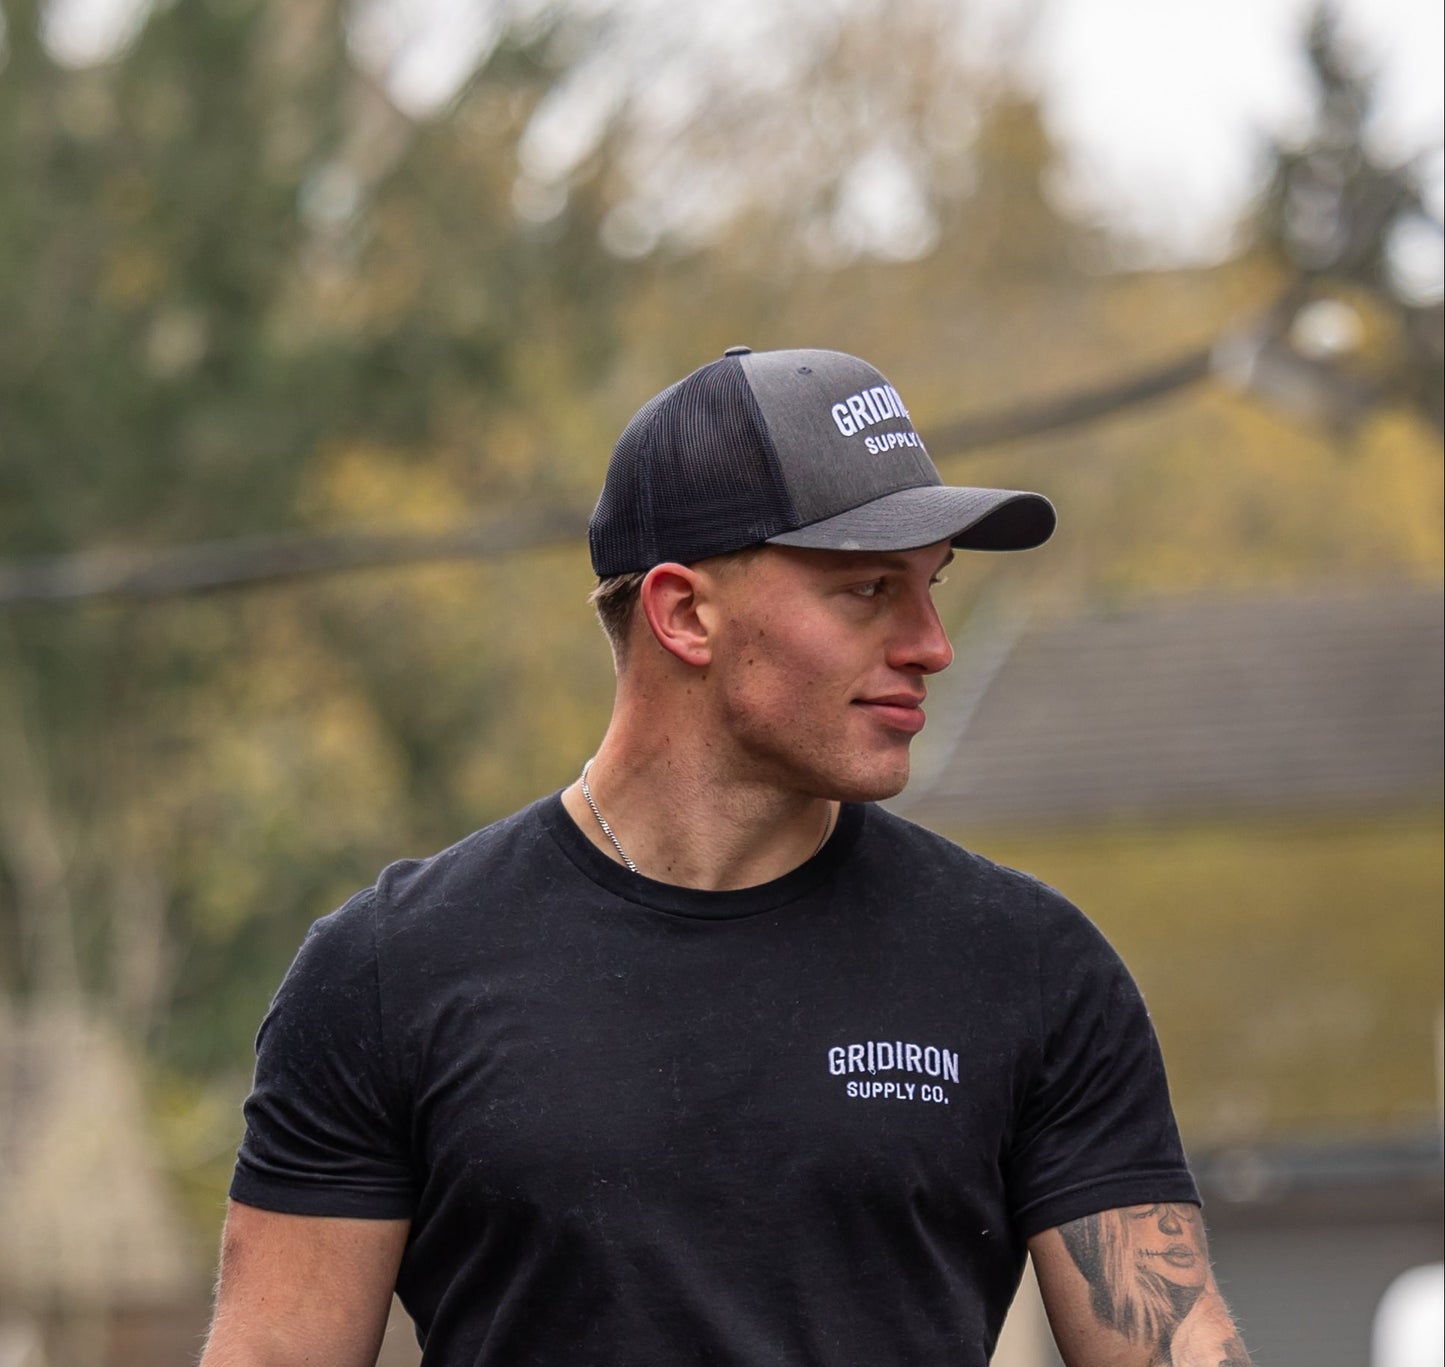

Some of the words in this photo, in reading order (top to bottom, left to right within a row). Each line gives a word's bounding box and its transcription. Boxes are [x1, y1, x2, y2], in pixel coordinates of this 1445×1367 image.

[864, 432, 918, 454] SUPPLY
[828, 1041, 960, 1084] GRIDIRON
[846, 1081, 916, 1101] SUPPLY
[921, 1084, 949, 1105] CO.
